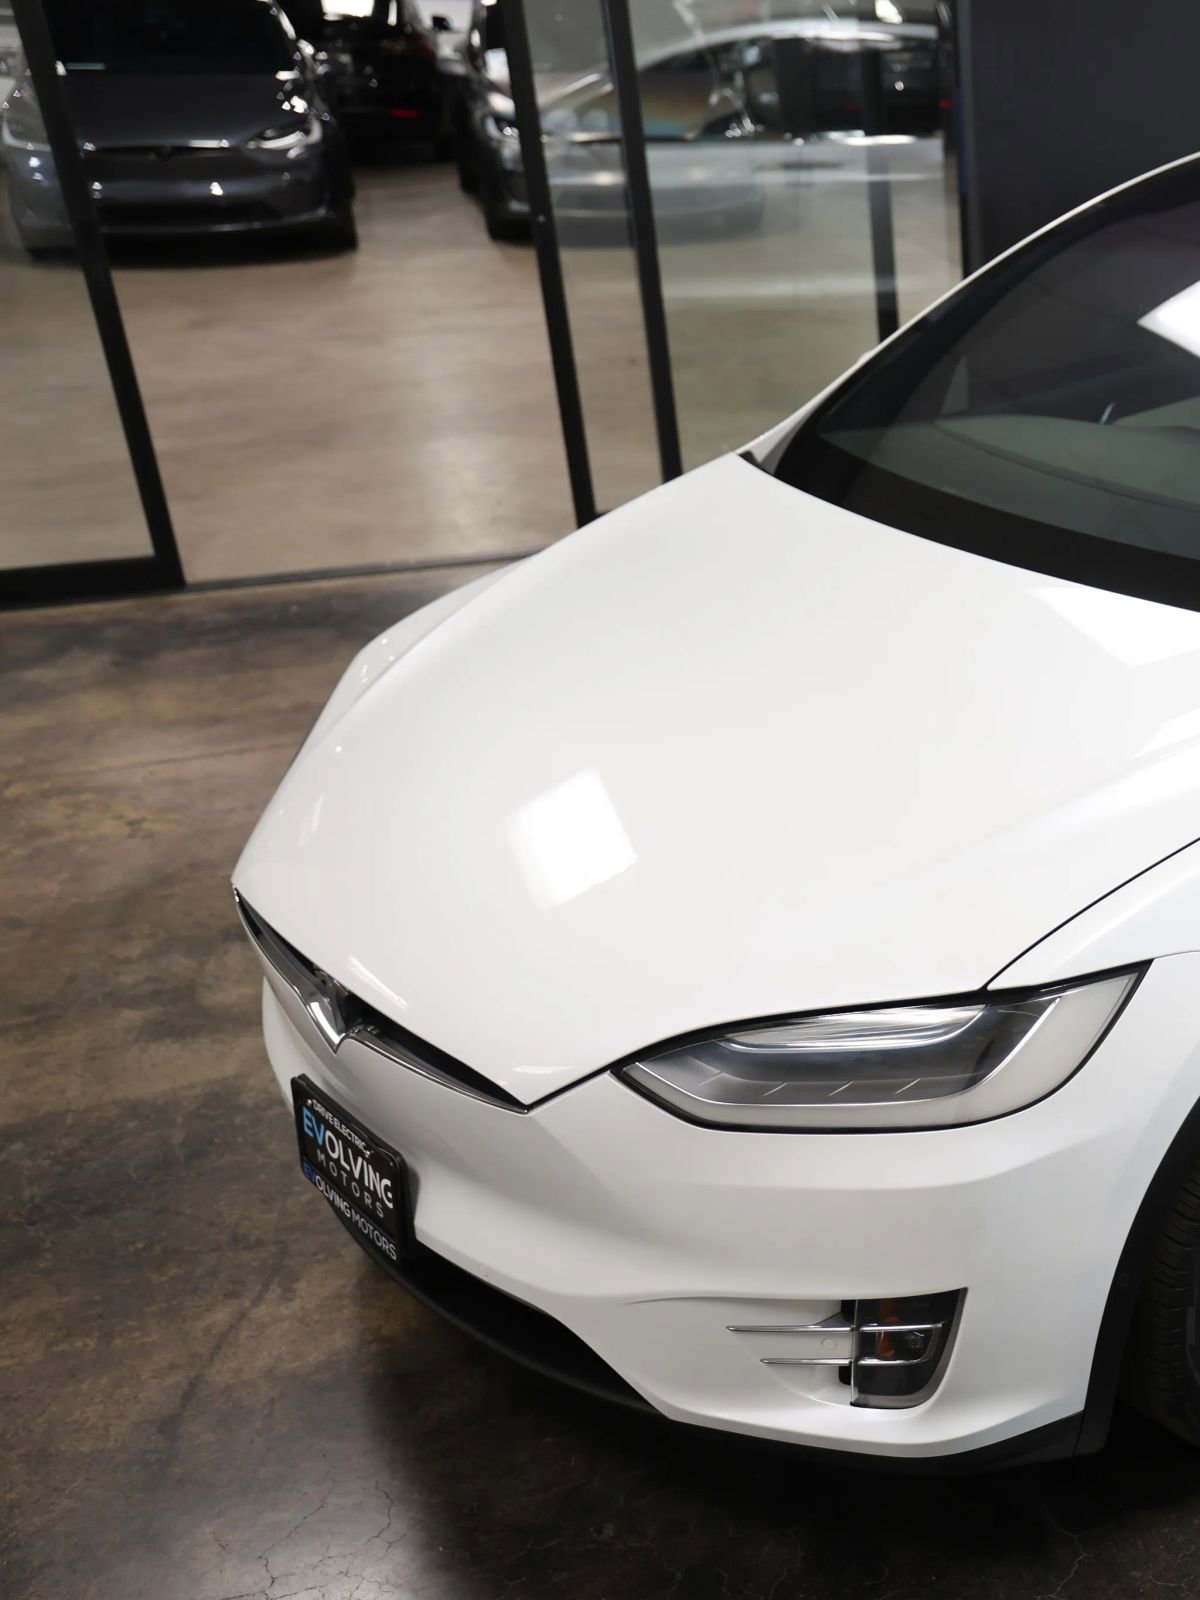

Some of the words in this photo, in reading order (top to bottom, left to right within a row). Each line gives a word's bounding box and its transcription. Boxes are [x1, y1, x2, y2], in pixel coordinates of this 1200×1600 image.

[303, 1106, 393, 1209] EVOLVING
[312, 1099, 334, 1125] DRIVE
[333, 1116, 366, 1152] ELECTRIC
[303, 1158, 347, 1218] EVOLVING
[346, 1208, 397, 1260] MOTORS
[317, 1148, 384, 1218] MOTORS
